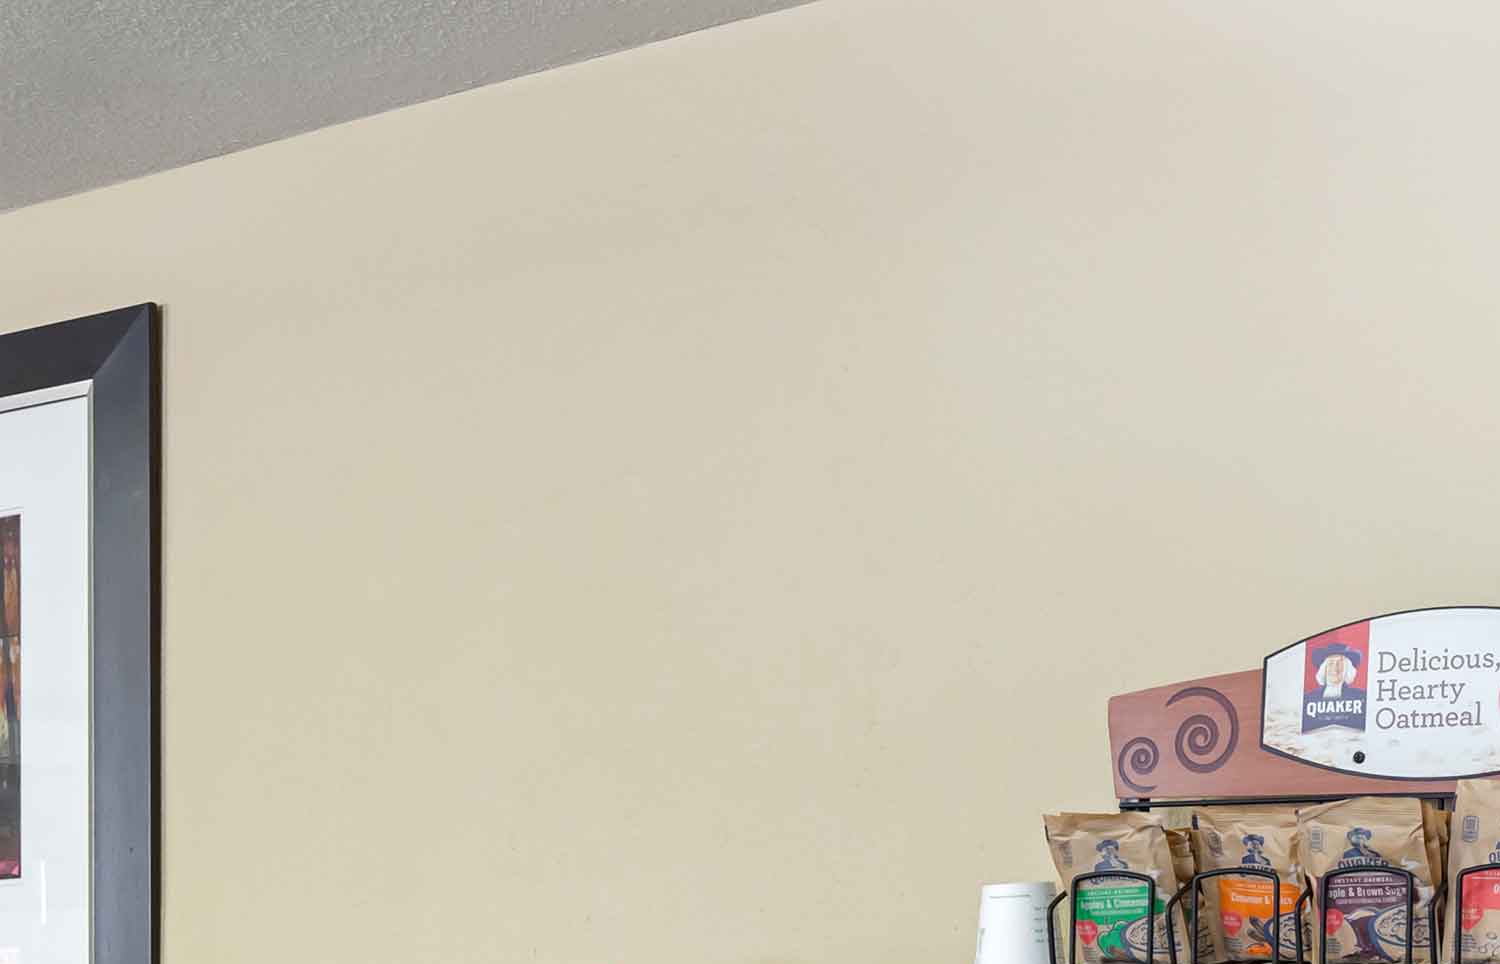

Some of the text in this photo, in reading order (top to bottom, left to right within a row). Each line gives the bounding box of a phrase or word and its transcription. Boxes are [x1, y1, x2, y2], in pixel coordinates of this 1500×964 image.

[1378, 647, 1500, 673] Delicious,
[1376, 679, 1466, 704] Hearty
[1306, 698, 1362, 717] QUAKER
[1376, 701, 1482, 730] Oatmeal
[1357, 886, 1383, 898] Brown
